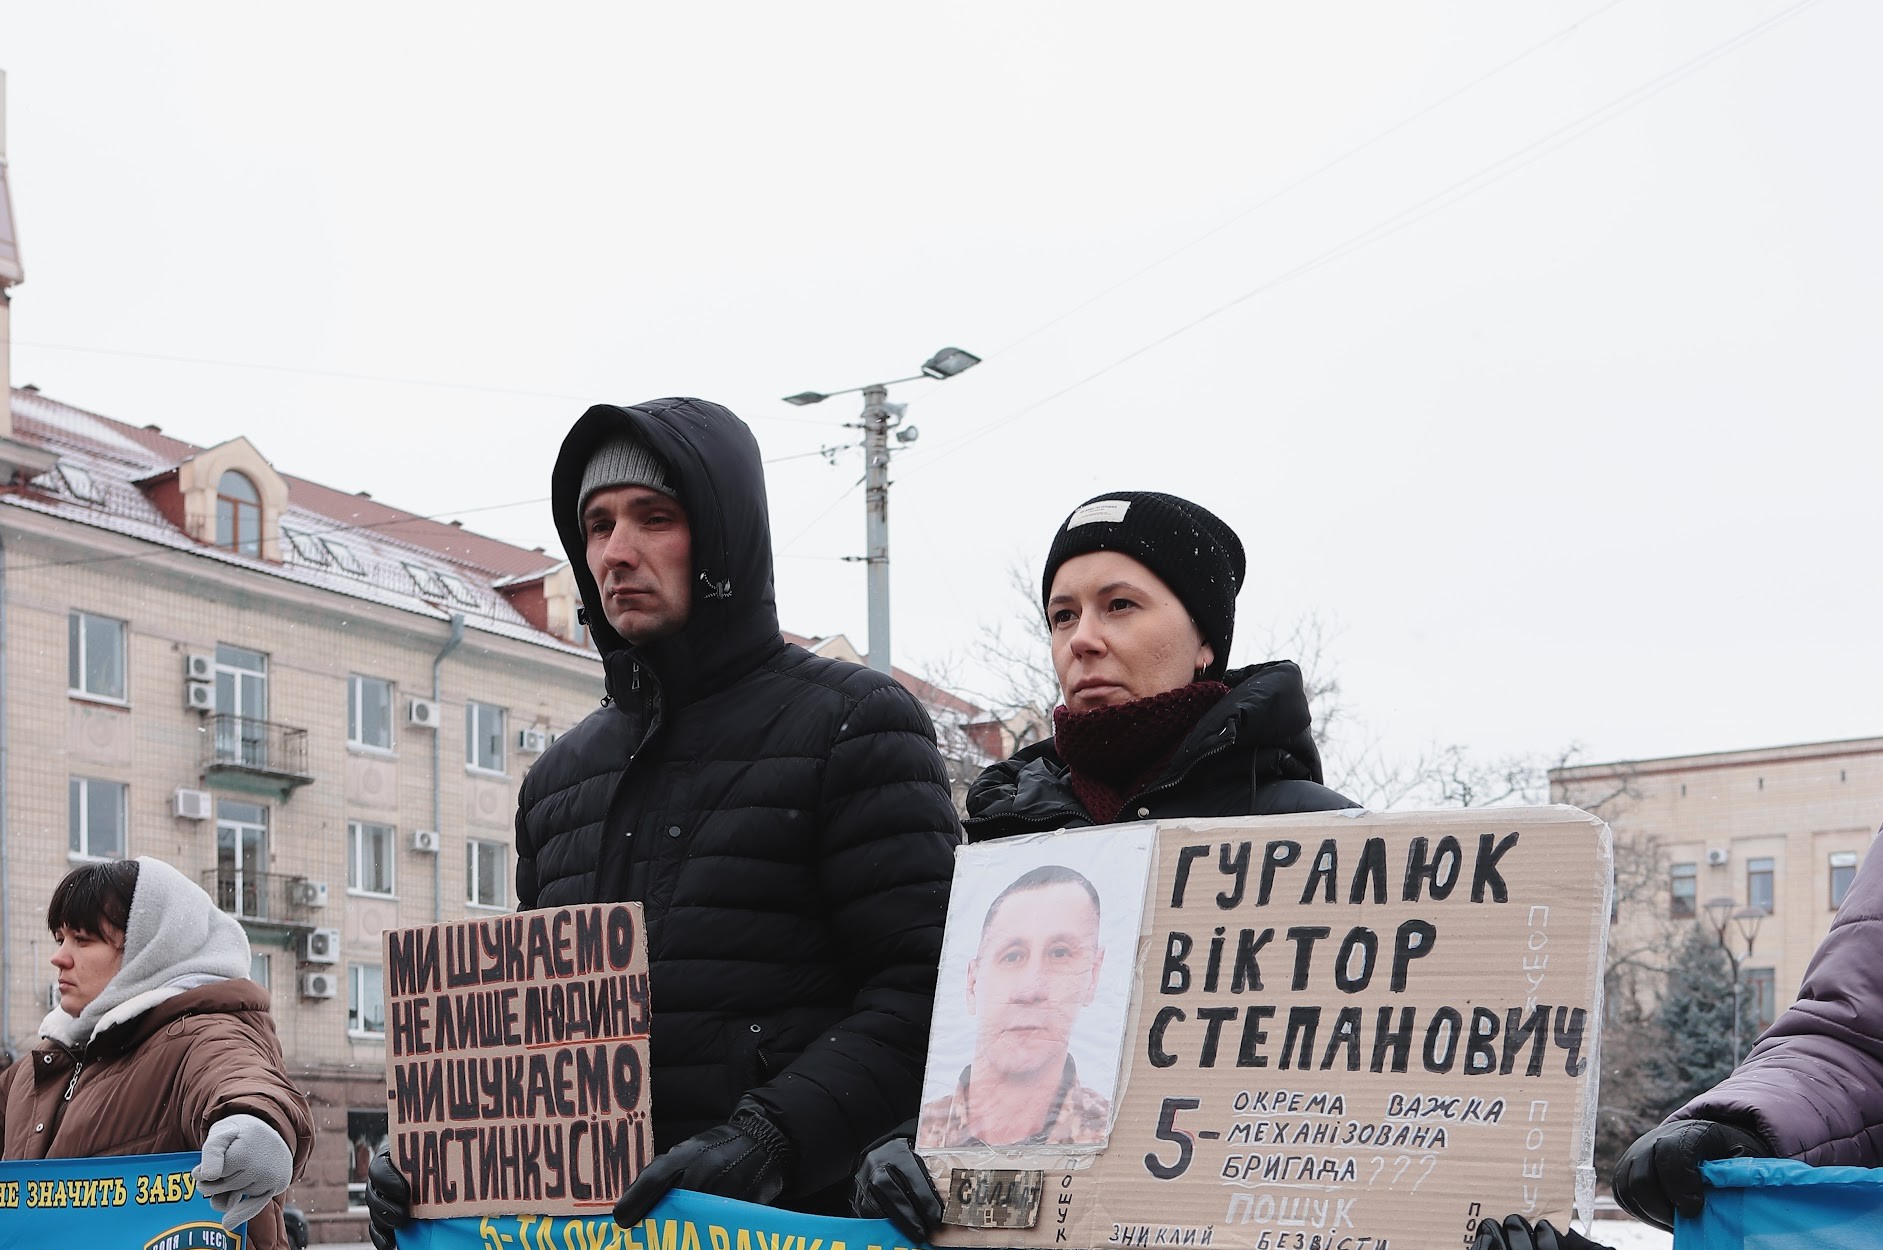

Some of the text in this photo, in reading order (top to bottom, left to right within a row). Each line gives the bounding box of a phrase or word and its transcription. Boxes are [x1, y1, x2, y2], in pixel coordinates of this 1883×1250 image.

[1169, 830, 1520, 910] ГУРАЛЮК
[389, 905, 635, 998] МИ ШУКАЄМО
[1521, 905, 1550, 1013] ПОШУК
[391, 973, 649, 1057] НЕ ЛИШЕ ЛЮДИНУ
[1147, 1004, 1587, 1078] СТЕПАНОВИЧ
[447, 1043, 643, 1121] ШУКАЄМО
[1233, 1091, 1505, 1123] ОКРЕМА ВАЖКА
[26, 1177, 128, 1209] ЗНАЧИТЬ
[136, 1171, 212, 1206] ЗАБУ
[398, 1123, 566, 1204] ЧАСТИНКУ
[1221, 1154, 1437, 1196] БРИГАДА ???
[1522, 1100, 1549, 1214] ПОШУ
[1109, 1223, 1215, 1249] ЗНИКЛИЙ
[1225, 1192, 1358, 1229] ПОШУК
